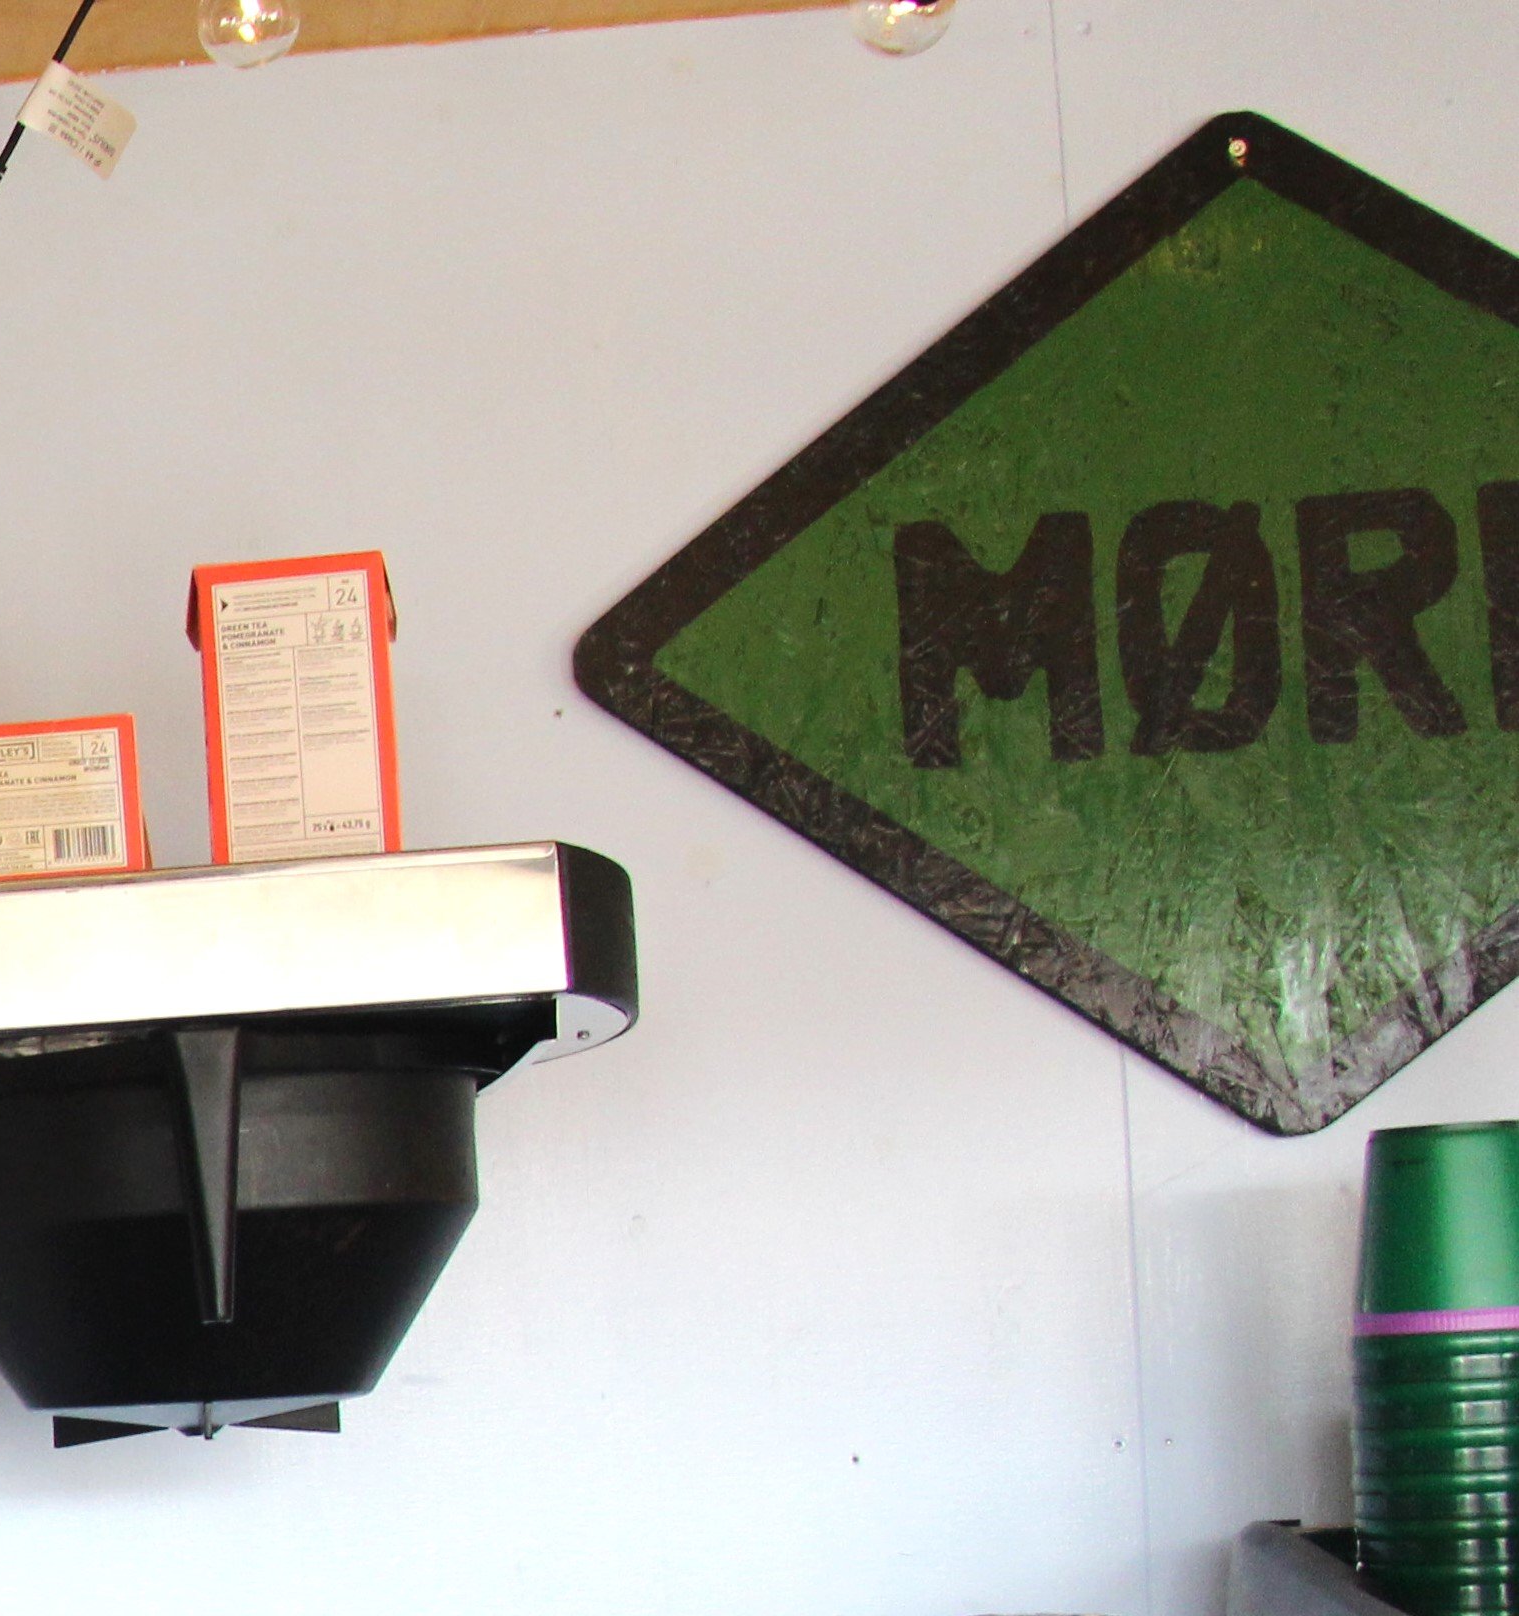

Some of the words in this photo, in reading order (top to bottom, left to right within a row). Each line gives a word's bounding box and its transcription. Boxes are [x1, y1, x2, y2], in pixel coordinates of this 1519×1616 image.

[334, 586, 358, 606] 24
[252, 621, 268, 630] TEA
[90, 741, 108, 755] 24
